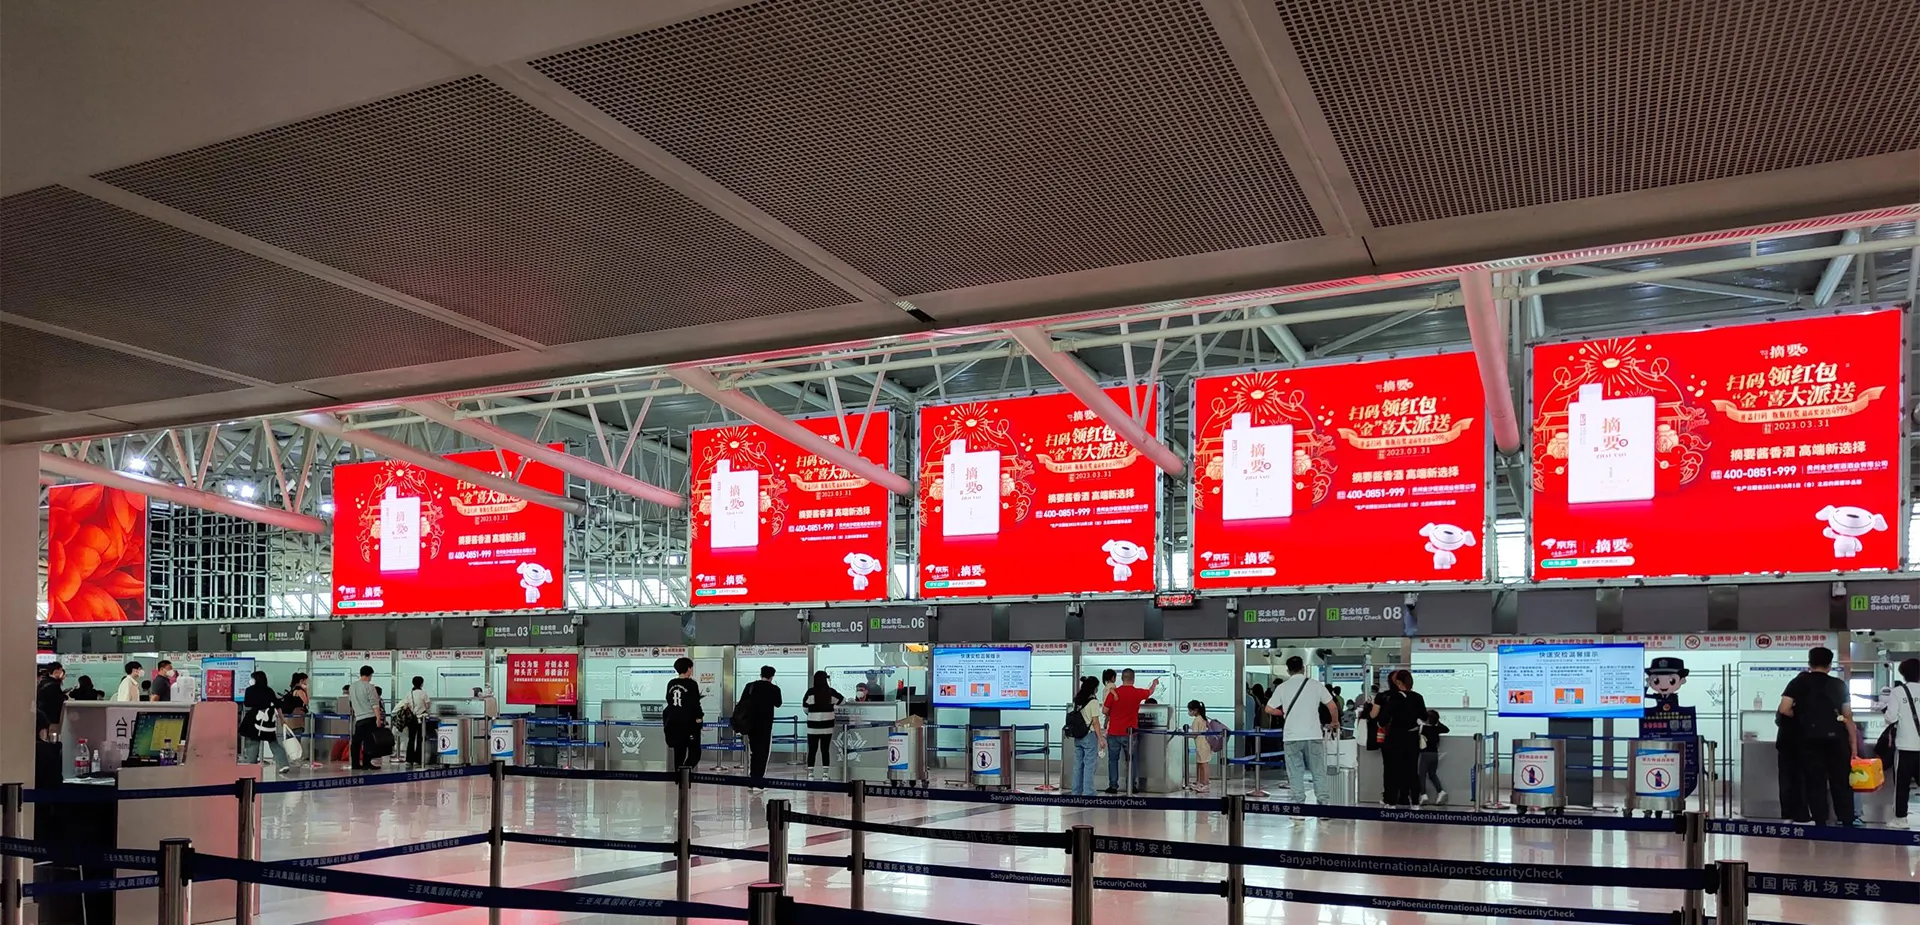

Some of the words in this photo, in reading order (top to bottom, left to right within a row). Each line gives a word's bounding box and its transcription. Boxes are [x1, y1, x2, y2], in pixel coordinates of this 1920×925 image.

[1769, 343, 1801, 359] 摘要
[1726, 362, 1838, 391] 扫码领红包
[1383, 379, 1408, 392] 摘要
[1073, 410, 1095, 421] 摘要
[1348, 396, 1437, 421] 扫码领红包
[1774, 419, 1830, 431] 2023.03.31
[1045, 425, 1117, 447] 扫码领红包
[1602, 417, 1621, 451] 摘要
[1251, 443, 1266, 473] 摘要
[1386, 447, 1430, 456] 2023.03.31
[1730, 445, 1796, 461] 摘要酱香酒
[1799, 441, 1866, 457] 高端新选择
[1075, 471, 1112, 480] 2023.03.31
[1352, 470, 1403, 483] 摘要酱香酒
[1406, 466, 1459, 480] 高端新选择
[1724, 465, 1796, 479] 400-0851-999
[965, 467, 978, 495] 摘要
[729, 485, 741, 510] 摘要
[1048, 492, 1090, 504] 摘要酱香酒
[1091, 488, 1135, 501] 高端新选择
[1347, 487, 1405, 499] 400-0851-999
[799, 508, 833, 519] 摘要酱香酒
[835, 506, 871, 517] 高端新选择
[1043, 508, 1091, 518] 400-0851-999
[795, 523, 834, 533] 400-0851-999
[458, 534, 491, 546] 摘要酱香酒
[492, 532, 526, 544] 高端新选择
[1556, 540, 1577, 550] 京东
[1596, 538, 1628, 553] 摘要
[454, 550, 492, 559] 400-0851-999
[1213, 552, 1230, 561] 京东
[1244, 551, 1271, 565] 摘要
[961, 564, 982, 577] 摘要
[726, 574, 744, 585] 摘要
[1870, 594, 1910, 604] 安全检查
[1258, 609, 1285, 617] 安全检查
[1298, 608, 1316, 622] 07
[1341, 607, 1370, 615] 安全检查
[1383, 606, 1402, 620] 08
[563, 624, 574, 634] 04
[850, 621, 863, 632] 05
[911, 617, 925, 629] 06
[146, 635, 154, 643] V2
[259, 633, 267, 641] 01
[295, 632, 304, 640] 02
[517, 627, 528, 637] 03
[1775, 634, 1827, 642] 禁止拍照及摄像
[407, 768, 464, 781] 三亚凤凰国际机场安检
[297, 777, 365, 790] 三亚凤凰国际机场安检
[990, 793, 1148, 807] SanyaPhoenixInternationalAirportSecurityCheck
[1380, 810, 1584, 826] SanyaPhoenixInternationalAirportSecurityCheck
[1705, 822, 1805, 837] 凰国际机场安检
[1096, 838, 1173, 855] 国际机场安检
[292, 853, 360, 867] 三亚凤凰国际机场安检
[1279, 853, 1563, 880] SanyaPhoenixInternationalAirportSecurityCheck
[262, 868, 327, 884] 三亚凤凰国际机场安检
[408, 884, 483, 899] 三亚凤凰国际机场安检
[1372, 898, 1575, 918] SanyaPhoenixInternationalAirportSecurityCheck
